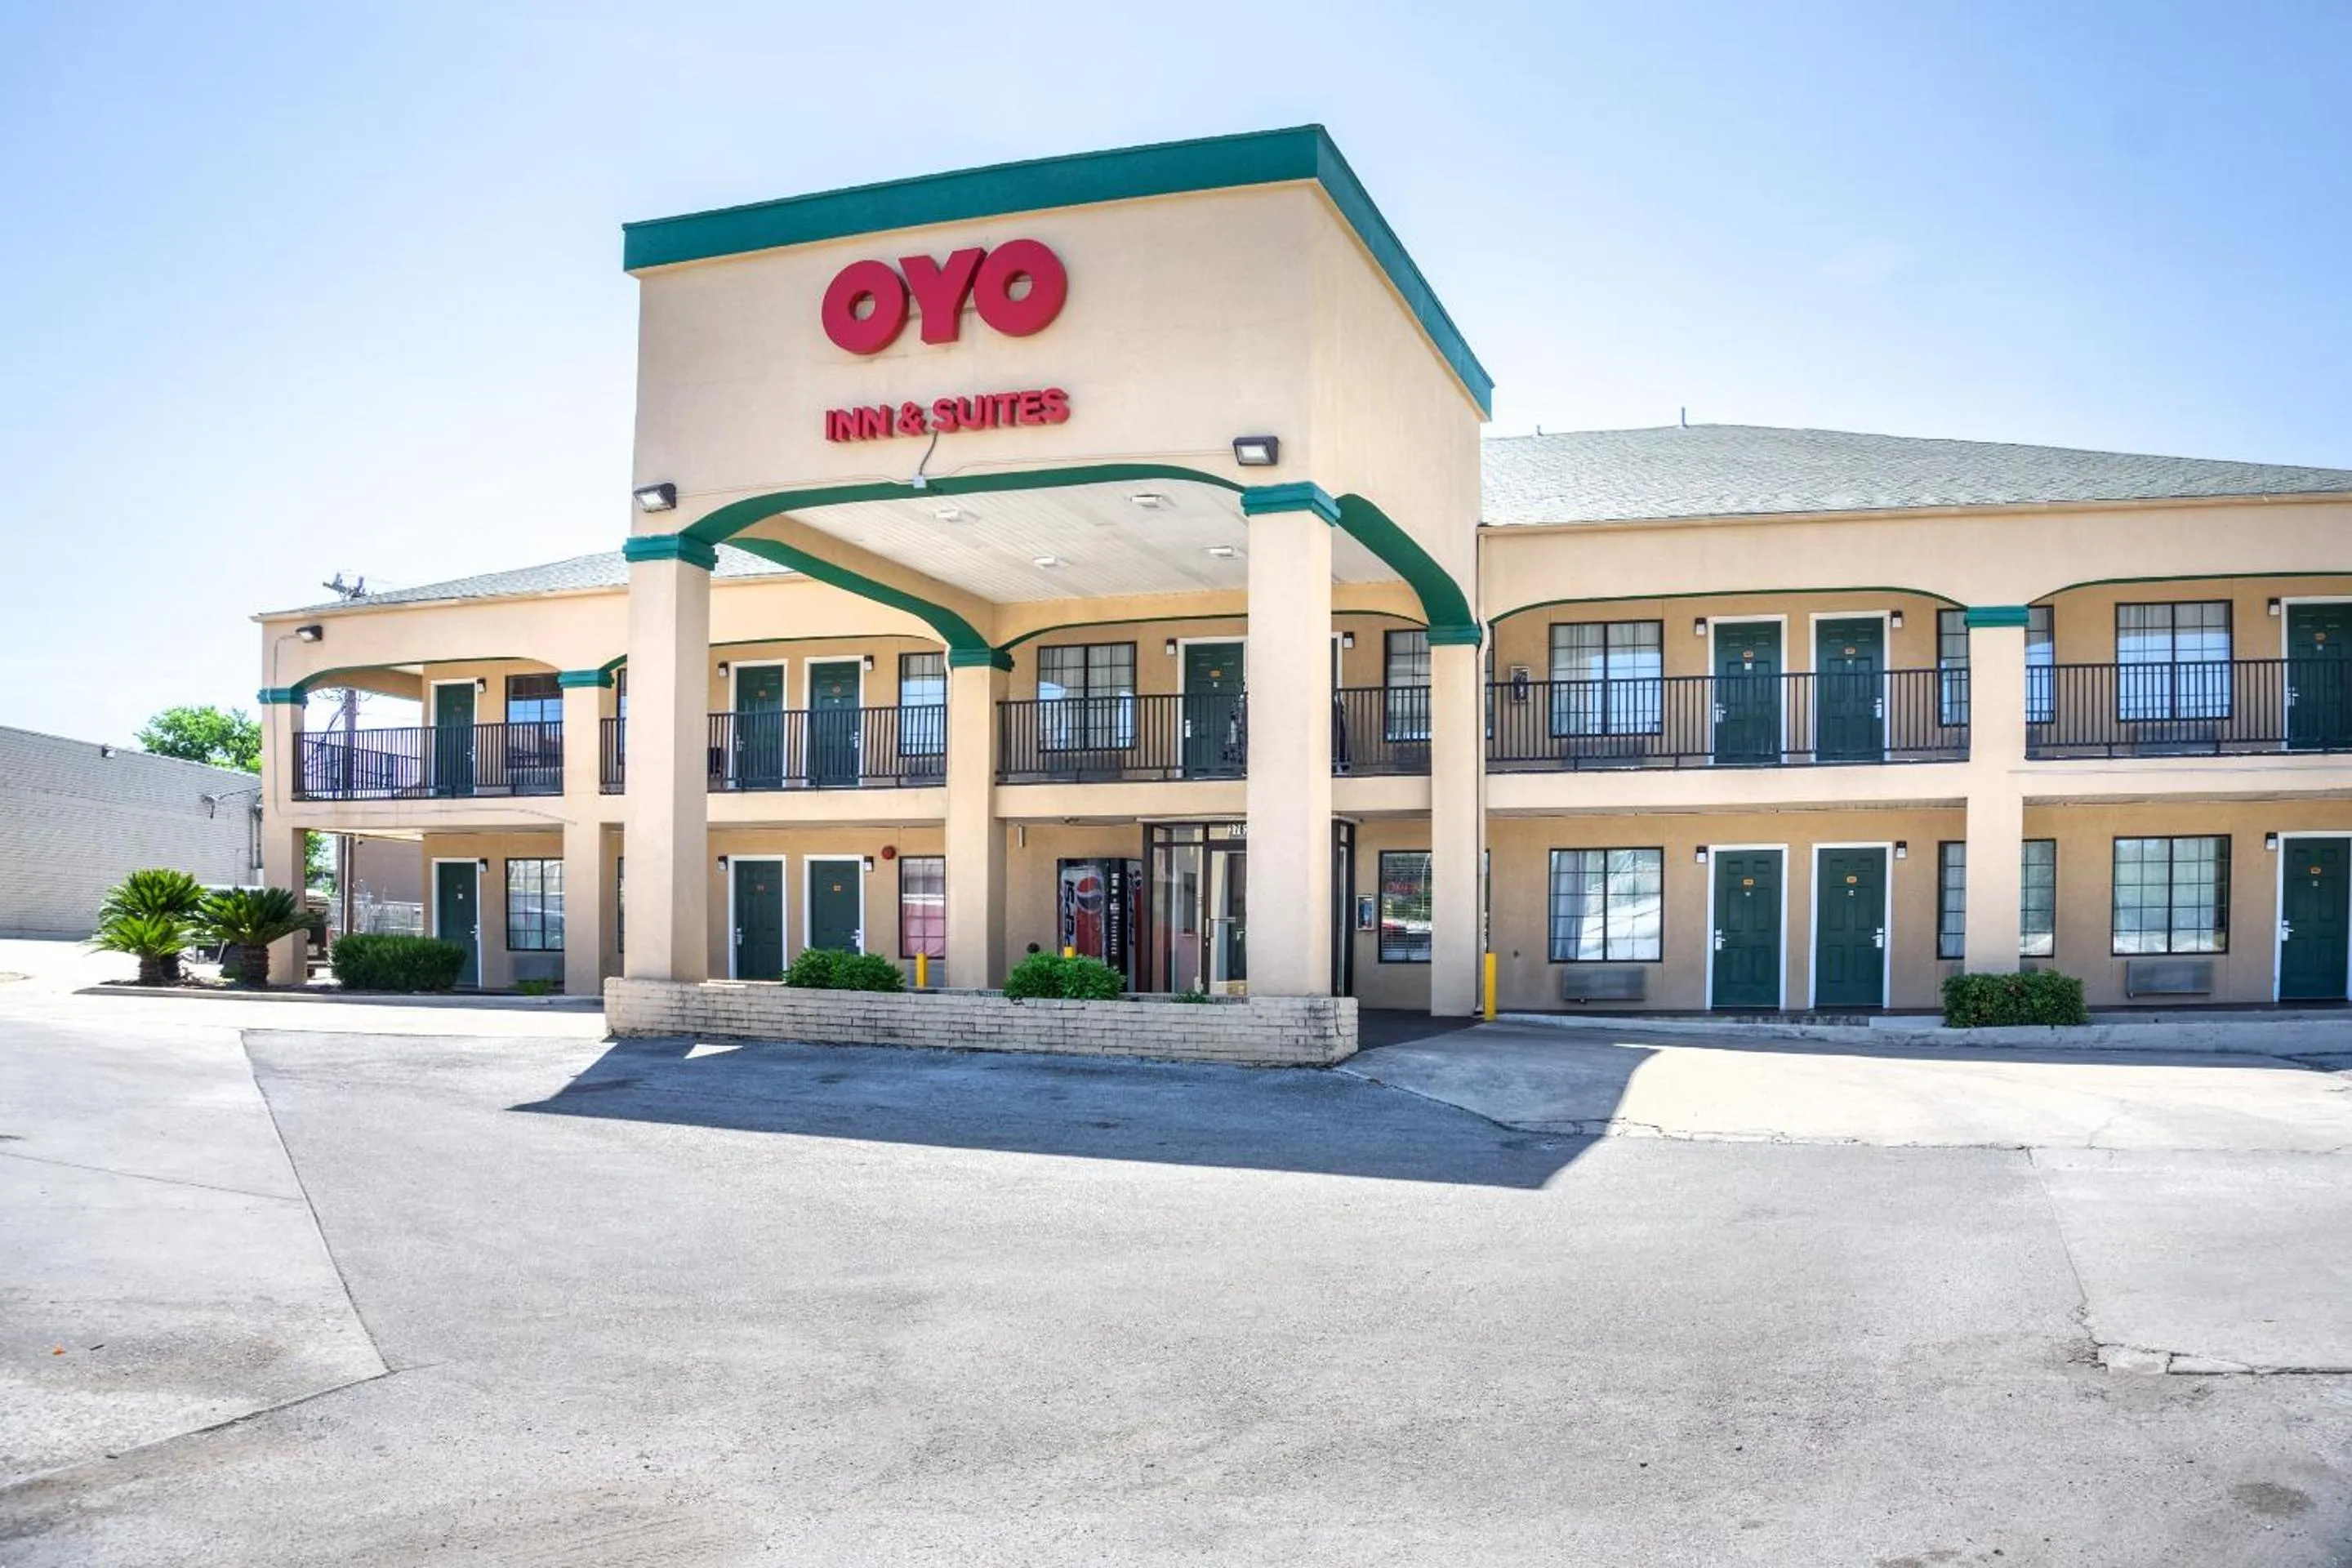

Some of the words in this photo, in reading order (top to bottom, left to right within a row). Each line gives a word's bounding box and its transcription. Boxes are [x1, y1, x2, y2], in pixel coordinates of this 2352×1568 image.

[822, 238, 1067, 354] OYO
[826, 405, 894, 443] INN
[897, 401, 927, 436] &
[932, 388, 1070, 433] SUITES
